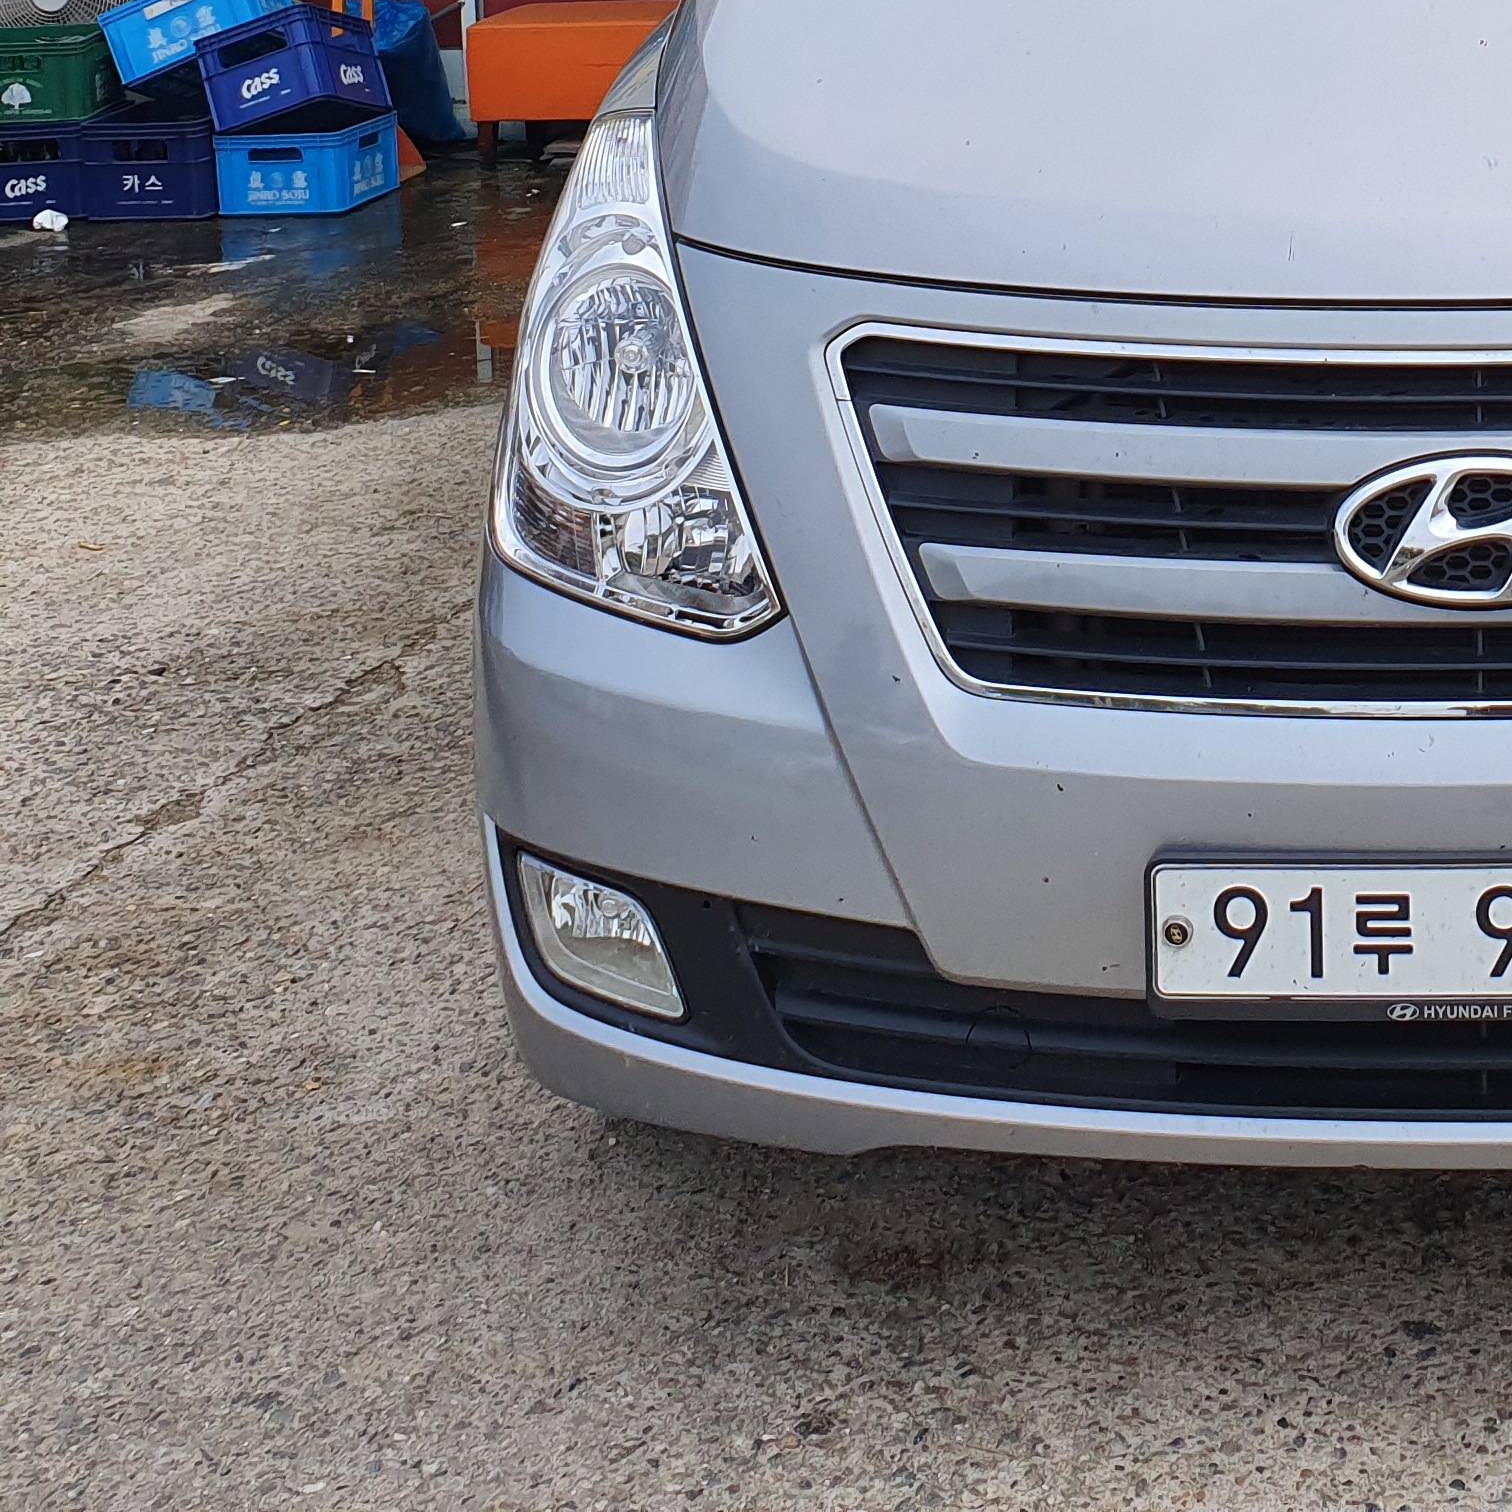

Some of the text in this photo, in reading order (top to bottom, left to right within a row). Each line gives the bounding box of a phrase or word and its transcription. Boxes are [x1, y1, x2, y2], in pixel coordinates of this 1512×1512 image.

[240, 68, 280, 99] Cass
[340, 63, 364, 85] Cass
[4, 175, 47, 199] Cass
[122, 174, 163, 193] 카스
[1213, 885, 1415, 978] 91루
[1423, 1004, 1499, 1019] HYUNDAI
